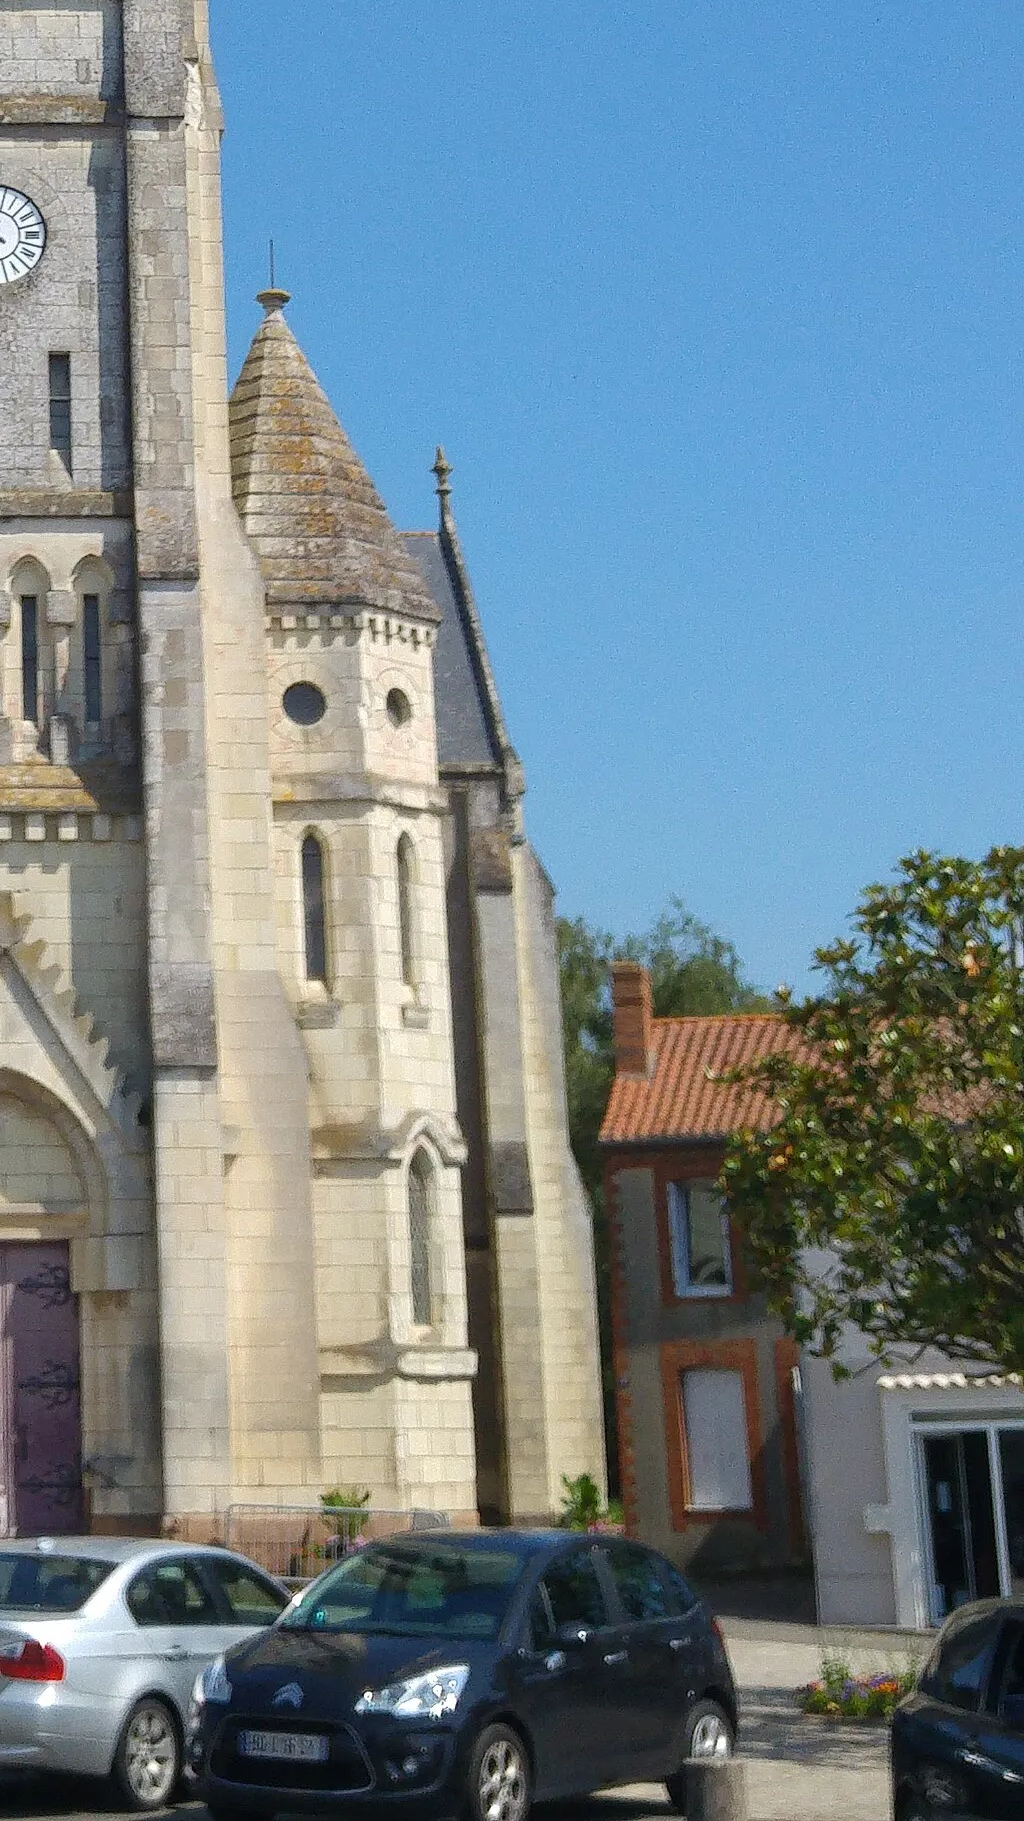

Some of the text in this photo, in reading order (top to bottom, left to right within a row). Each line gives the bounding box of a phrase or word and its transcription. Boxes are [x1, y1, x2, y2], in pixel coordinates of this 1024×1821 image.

[8, 196, 18, 211] I
[19, 211, 35, 223] II
[25, 230, 40, 240] III
[9, 260, 21, 276] V
